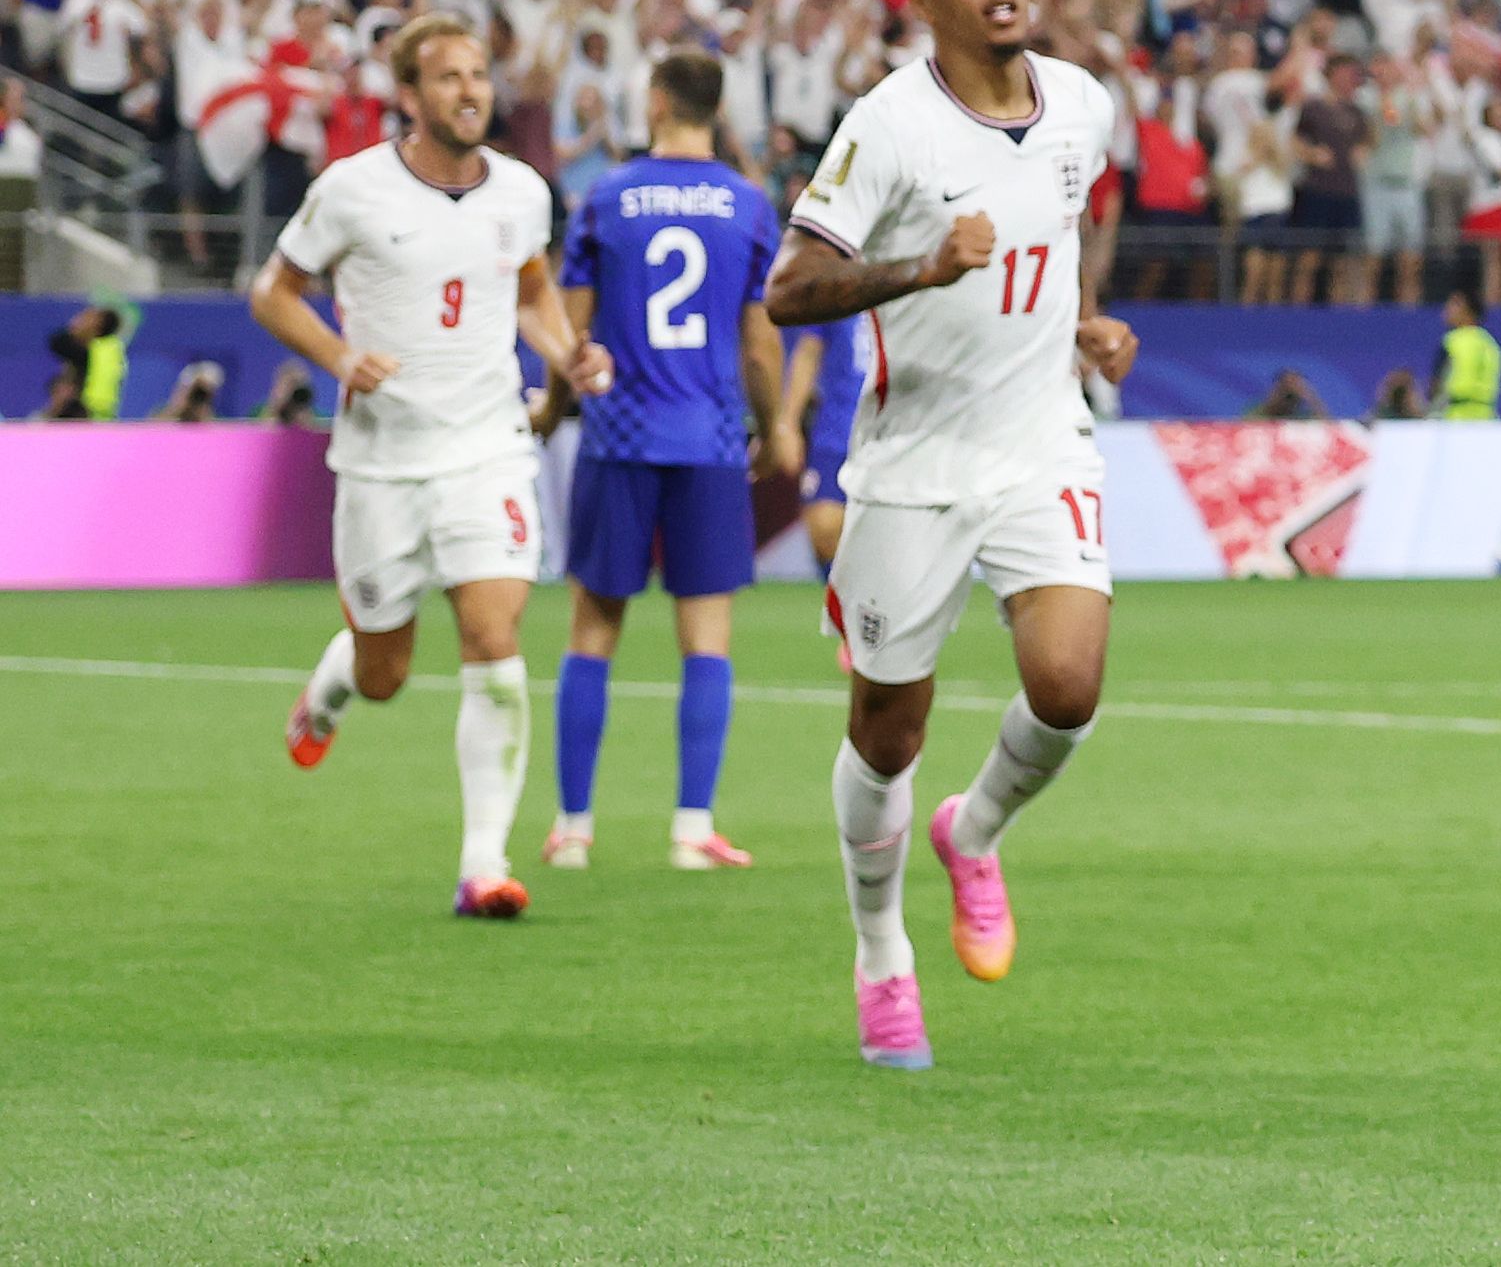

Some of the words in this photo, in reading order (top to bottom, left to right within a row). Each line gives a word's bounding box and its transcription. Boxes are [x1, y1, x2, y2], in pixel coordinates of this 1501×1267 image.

[441, 279, 463, 328] 9
[645, 226, 708, 350] 2
[1001, 245, 1048, 315] 17
[504, 498, 527, 544] 9
[1060, 487, 1102, 546] 17
